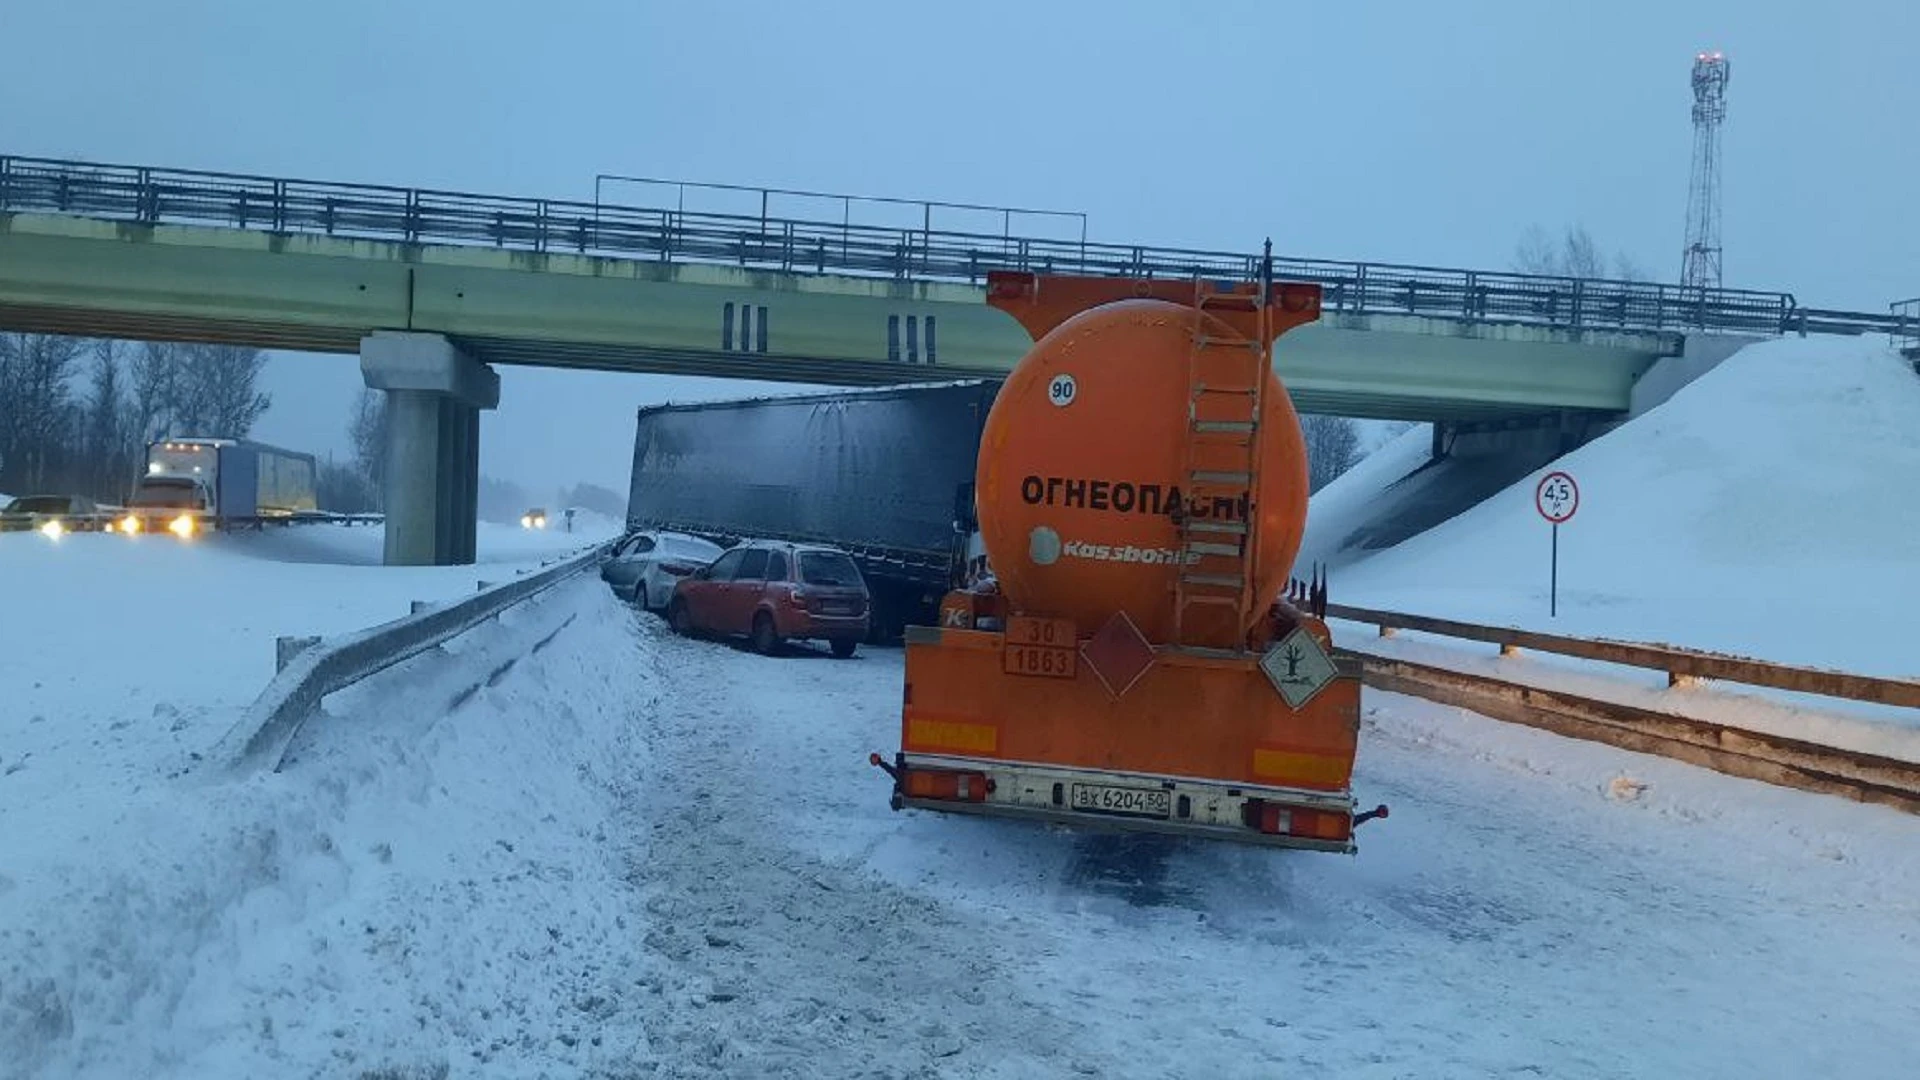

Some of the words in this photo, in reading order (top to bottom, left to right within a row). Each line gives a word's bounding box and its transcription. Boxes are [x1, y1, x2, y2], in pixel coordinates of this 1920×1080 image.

[1052, 381, 1073, 398] 90
[1544, 484, 1569, 502] 4,5
[1029, 621, 1055, 642] 30
[1016, 648, 1068, 673] 1863
